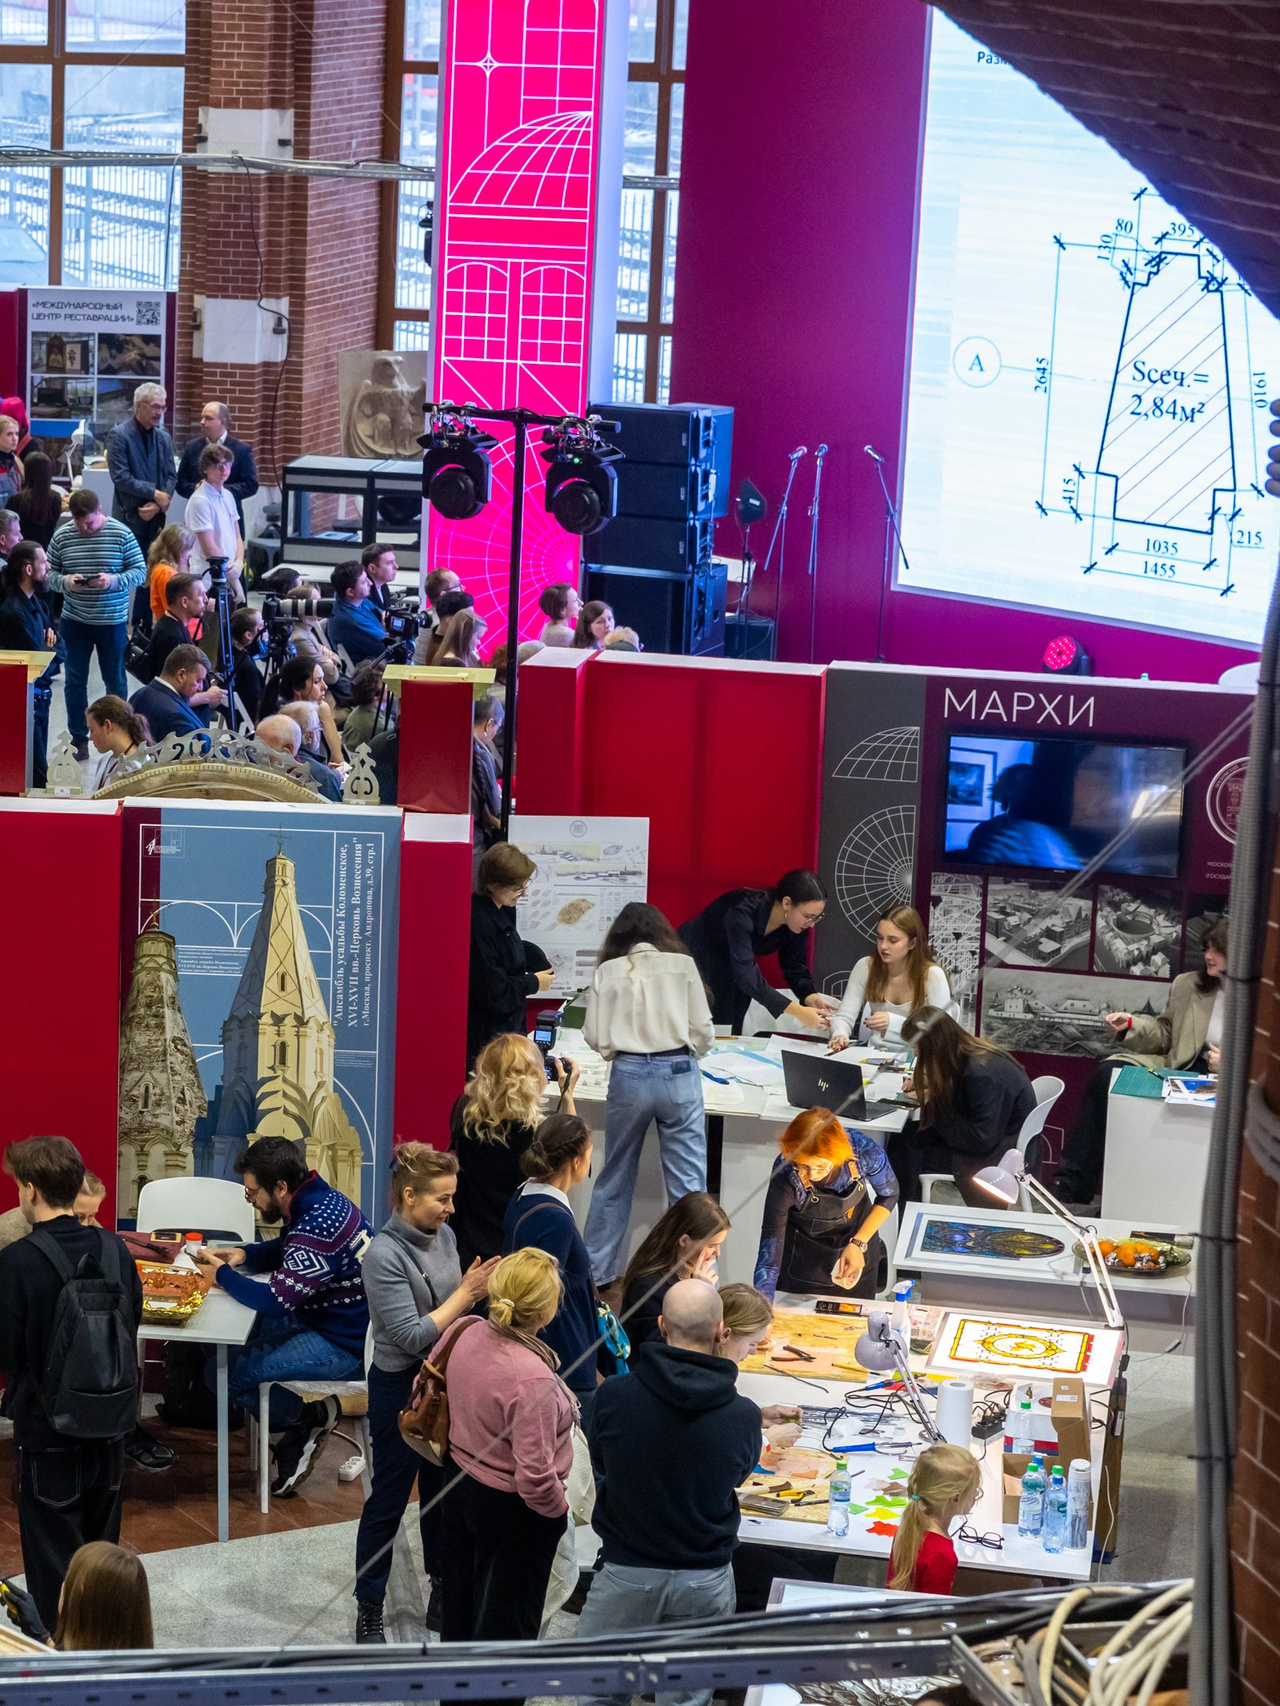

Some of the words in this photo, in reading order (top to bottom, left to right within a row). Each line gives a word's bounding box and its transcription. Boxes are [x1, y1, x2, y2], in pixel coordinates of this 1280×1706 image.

[1115, 218, 1133, 233] 80
[1170, 222, 1195, 237] 395
[1097, 234, 1113, 261] 130
[32, 301, 122, 310] «МЕЖДУНАРОДНЫЙ
[32, 313, 61, 321] ЦЕНТР
[64, 313, 134, 322] РЕСТАВРАЦИИ»
[1034, 357, 1049, 393] 2645
[1252, 372, 1268, 409] 1610
[1063, 478, 1075, 504] 415
[1146, 538, 1178, 556] 1035
[1236, 530, 1263, 545] 215
[1143, 560, 1176, 578] 1455
[944, 688, 1095, 727] МАРХИ
[336, 844, 349, 917] Коломенское,
[351, 837, 363, 904] Вознесения"
[336, 921, 347, 965] усадьбы
[333, 967, 345, 1026] "Ансамбль
[348, 976, 358, 1027] XVI-XVII
